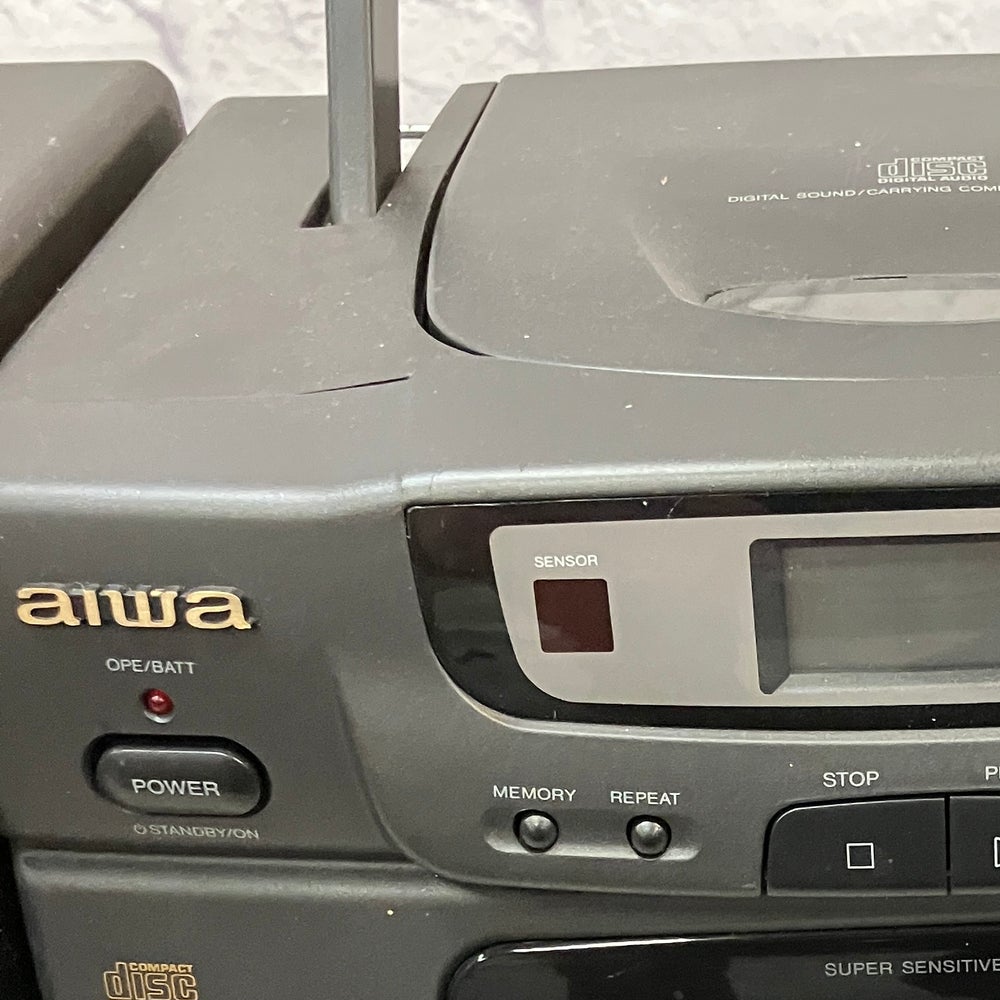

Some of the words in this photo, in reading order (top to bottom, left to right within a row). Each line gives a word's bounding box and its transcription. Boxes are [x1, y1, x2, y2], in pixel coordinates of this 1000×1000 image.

[878, 157, 987, 178] disc
[878, 175, 936, 184] DIGITAL
[727, 193, 790, 203] DIGITAL
[796, 186, 952, 199] SOUND/CARRYING
[533, 554, 599, 569] SENSOR
[15, 583, 254, 631] aiwa
[105, 657, 197, 675] OPE/BATT
[131, 778, 221, 797] POWER
[822, 770, 880, 788] STOP
[492, 784, 576, 803] MEMORY
[609, 790, 681, 806] REPEAT
[150, 824, 260, 840] STANDBY/ON
[129, 962, 193, 974] COMPACT
[825, 962, 892, 977] SUPER
